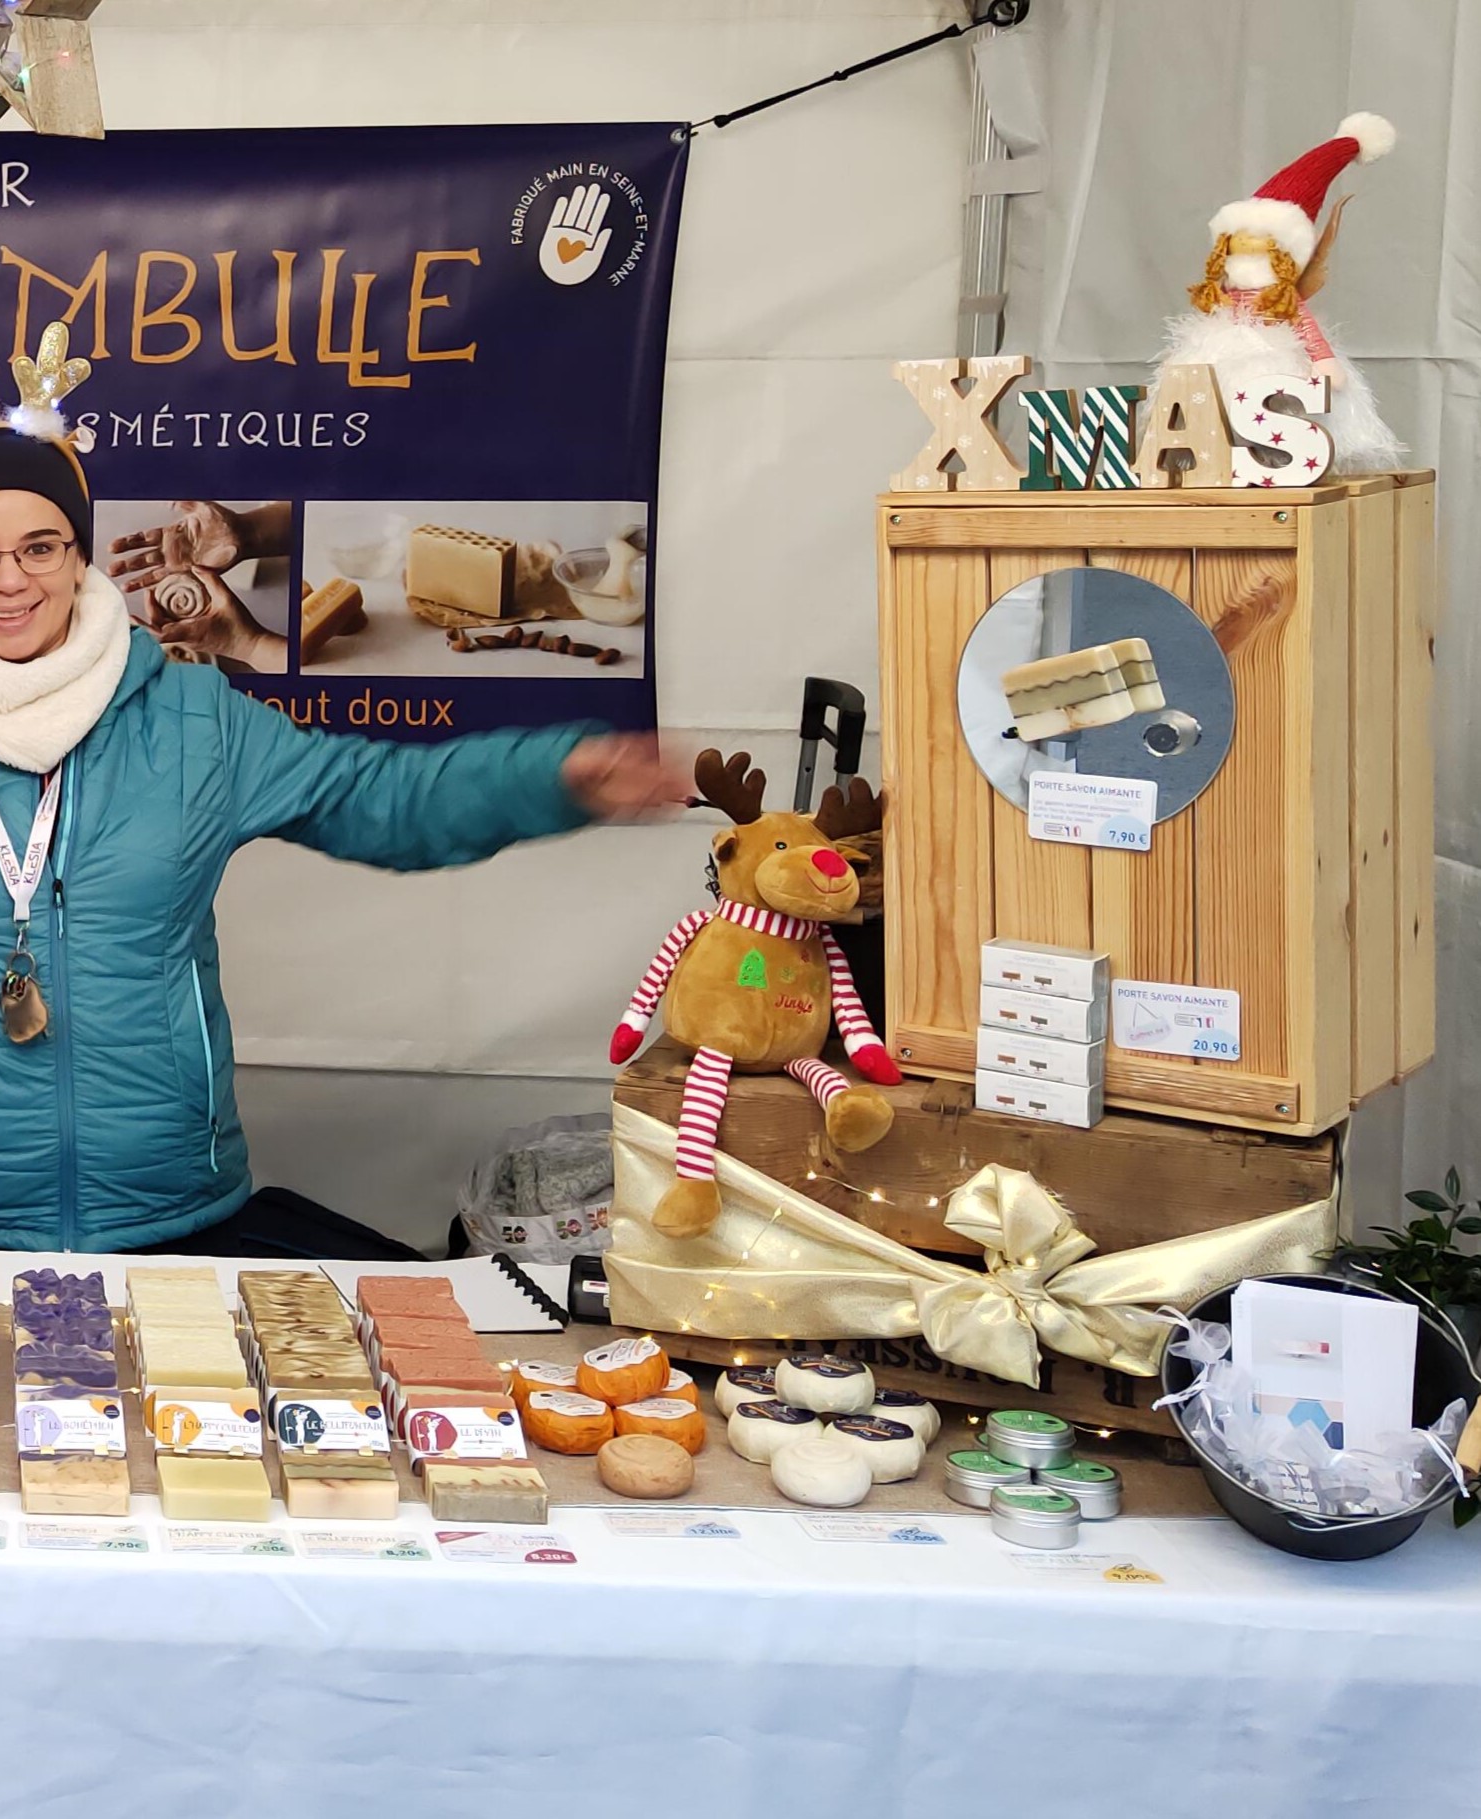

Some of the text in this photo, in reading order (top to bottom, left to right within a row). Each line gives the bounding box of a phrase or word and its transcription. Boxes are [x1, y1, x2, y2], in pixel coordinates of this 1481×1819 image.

[511, 162, 649, 287] FABRIQUÉ MAIN EN SEINE-ET-MARNE
[75, 402, 371, 449] SMÉTIQUES
[889, 355, 1332, 493] XMAS
[348, 687, 455, 728] doux
[1109, 830, 1136, 844] 7,90
[1118, 988, 1148, 999] PORTE
[1193, 1039, 1228, 1054] 20,90
